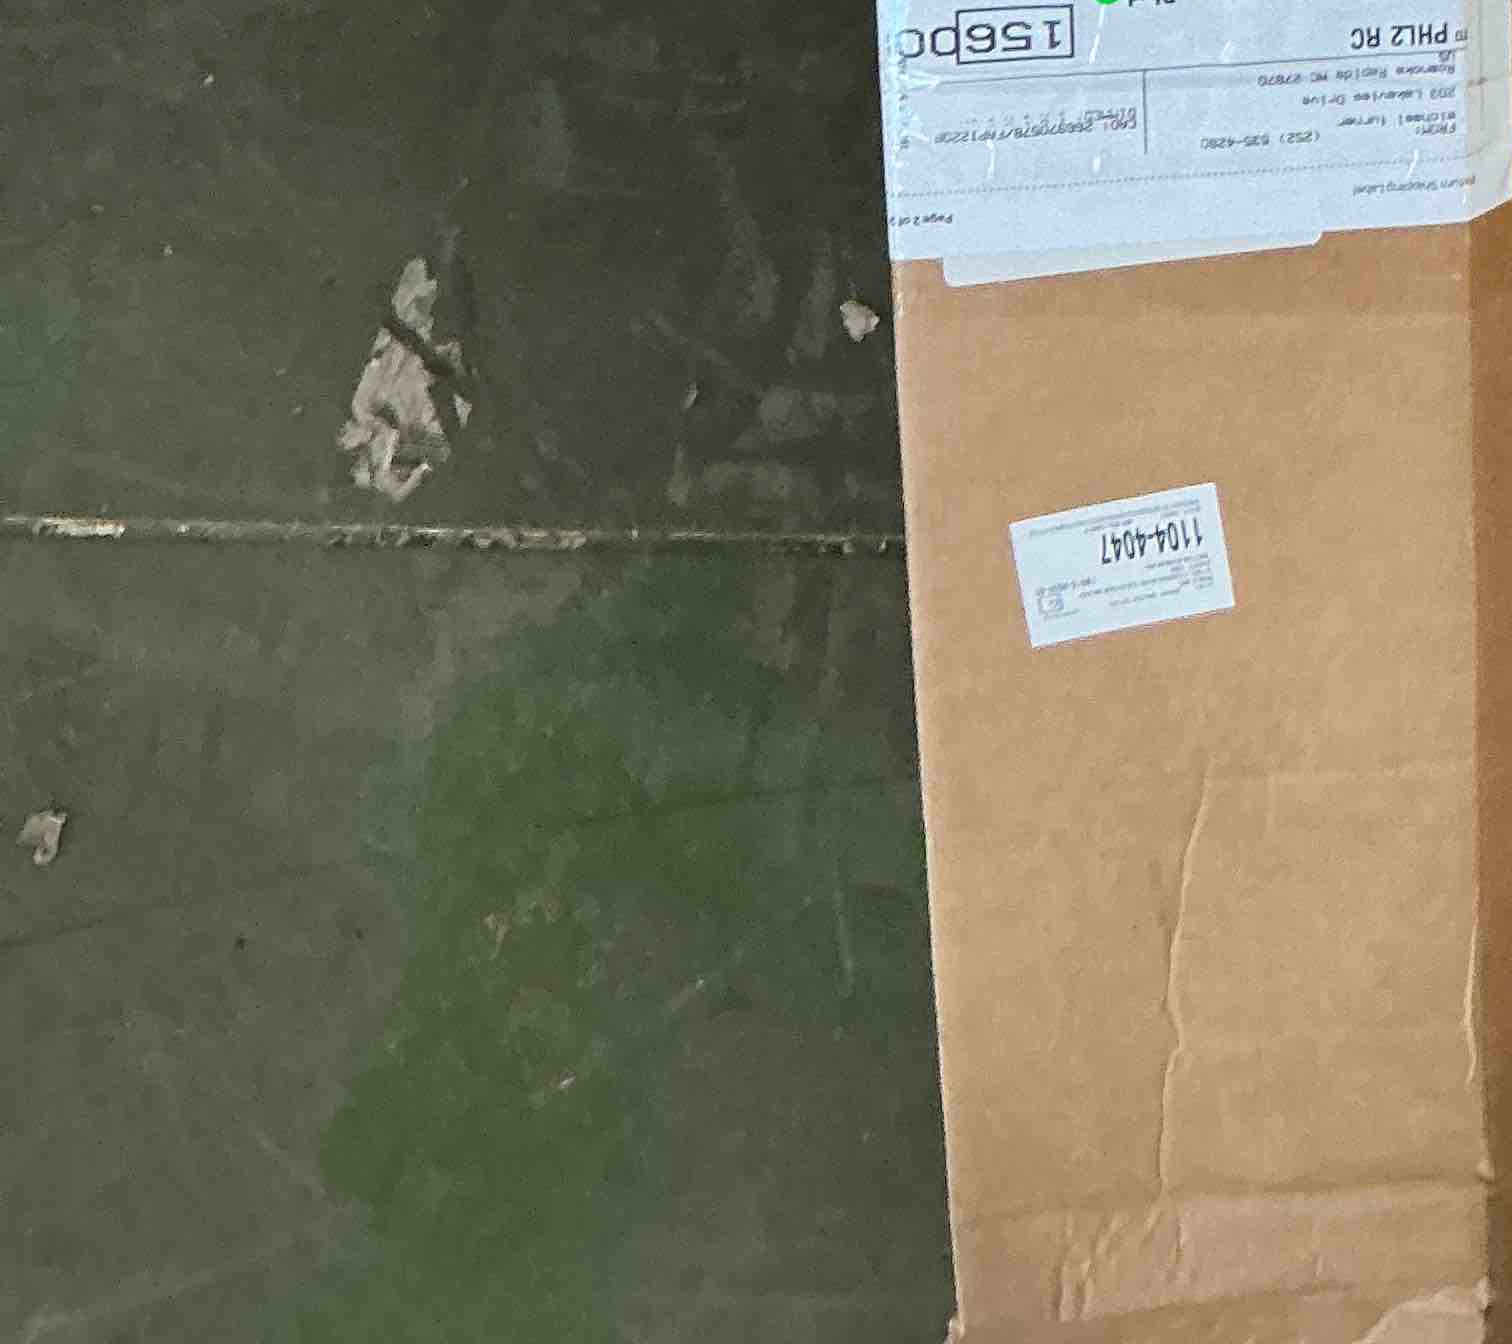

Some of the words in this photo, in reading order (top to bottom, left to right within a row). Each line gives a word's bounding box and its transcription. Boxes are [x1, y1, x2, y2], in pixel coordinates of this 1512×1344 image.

[1348, 25, 1380, 50] RC
[1390, 20, 1448, 48] PHL2
[1301, 92, 1345, 108] Drive
[921, 211, 952, 225] Page
[1100, 517, 1204, 566] 1104-4047
